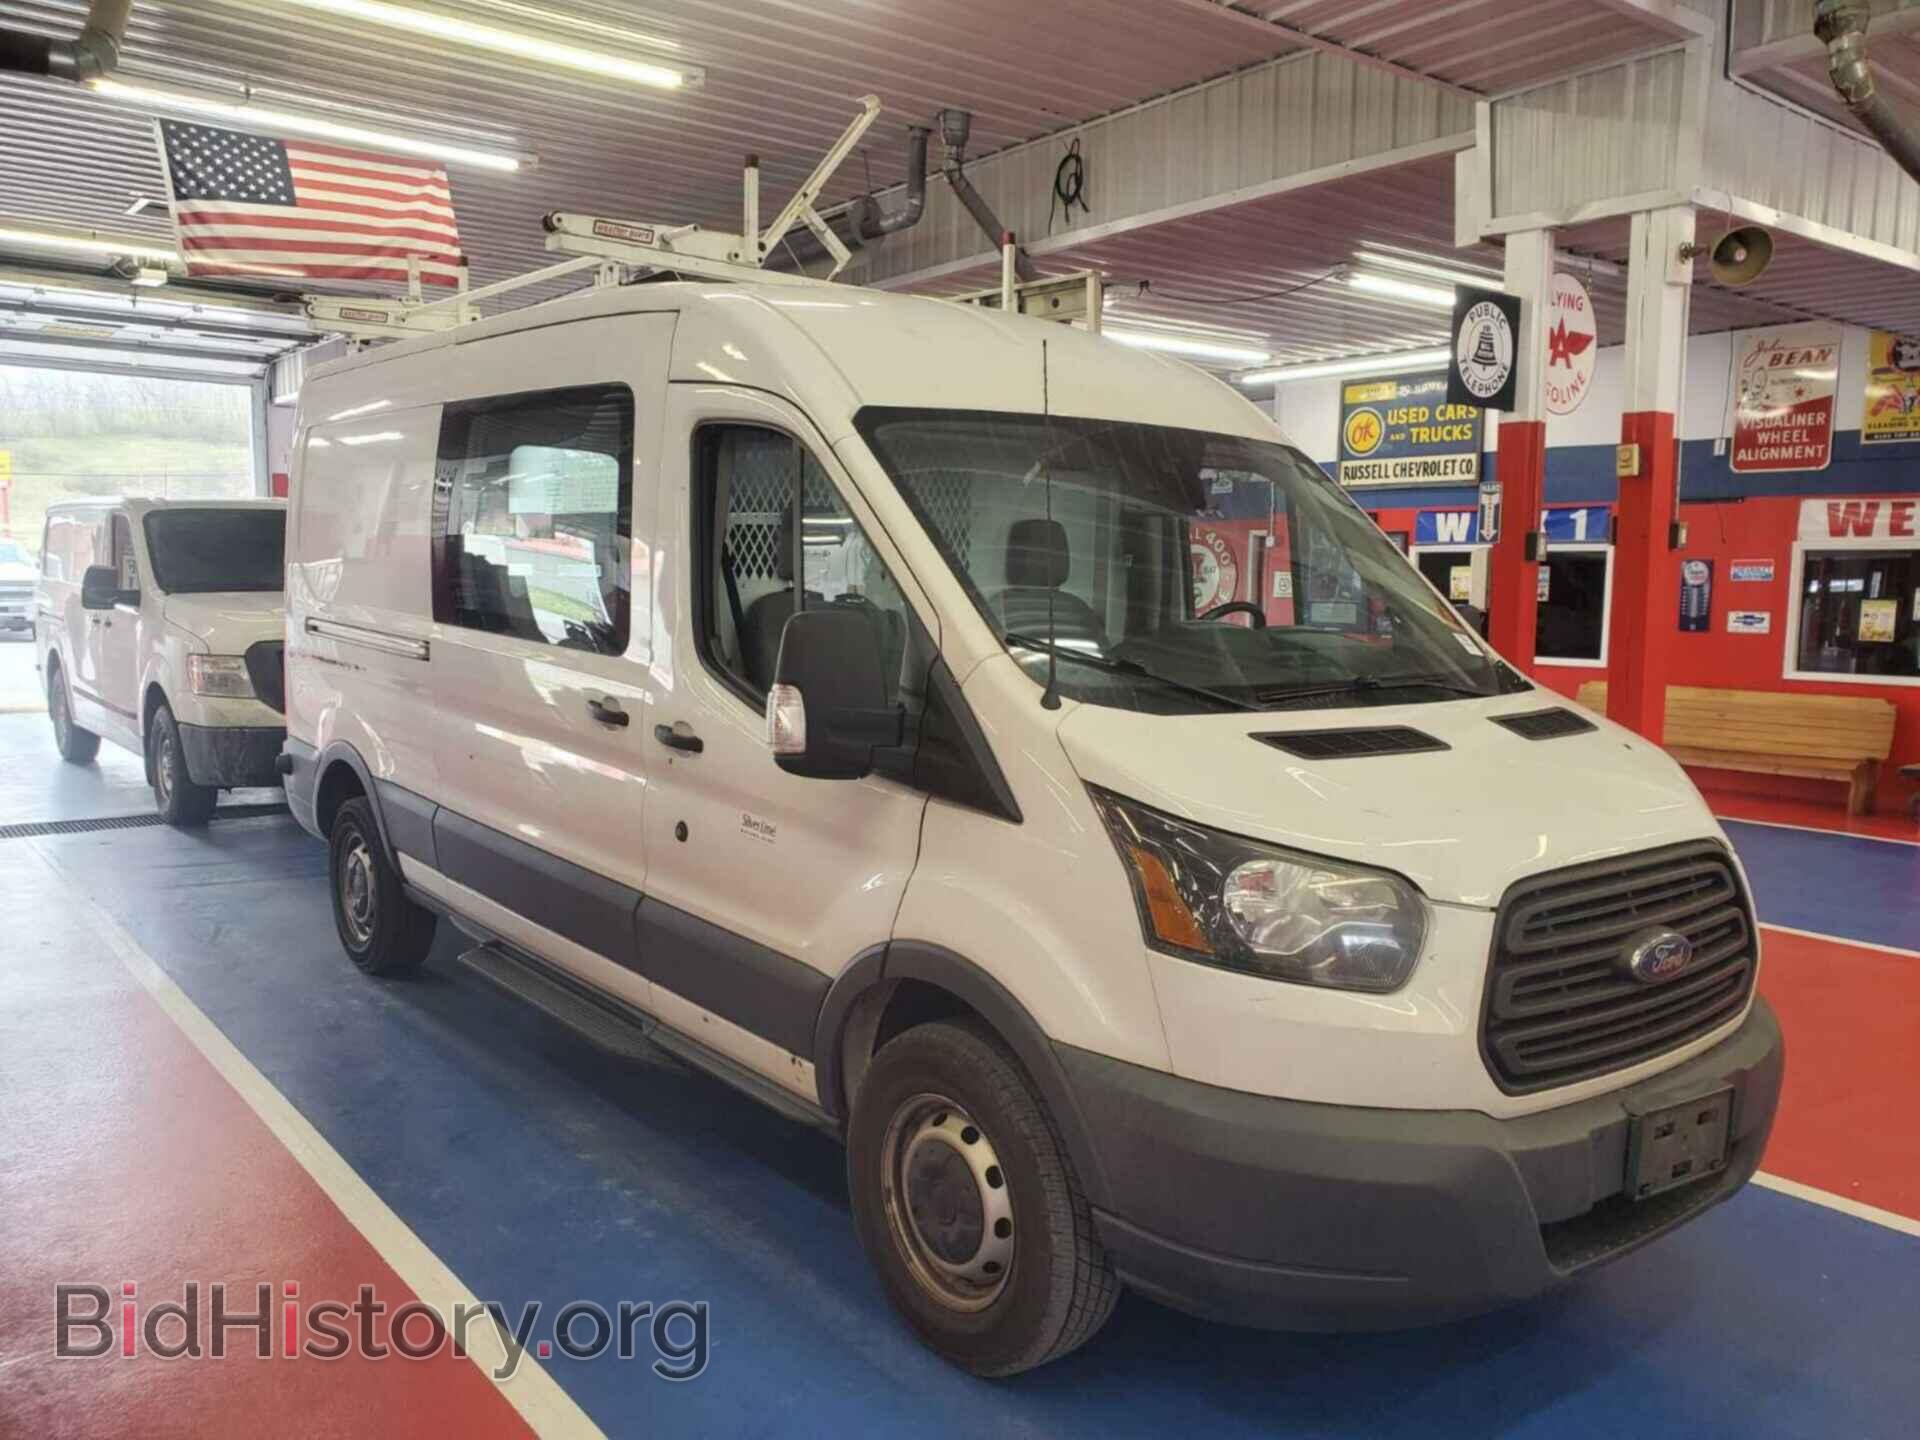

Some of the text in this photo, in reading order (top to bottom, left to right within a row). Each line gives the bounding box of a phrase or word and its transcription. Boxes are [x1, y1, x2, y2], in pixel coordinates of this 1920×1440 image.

[1468, 303, 1507, 330] PUBLIC
[1768, 347, 1832, 367] BEAN
[1459, 355, 1508, 394] TELEPHONE
[1387, 404, 1478, 425] USED CARS
[1410, 424, 1473, 443] TRUCKS
[1757, 430, 1810, 445] WHEEL
[1736, 445, 1825, 461] ALIGNMENT
[1343, 463, 1390, 481] RUSSELL
[1393, 459, 1458, 478] CHEVROLET
[1827, 502, 1916, 537] WE
[1653, 944, 1685, 973] Ford
